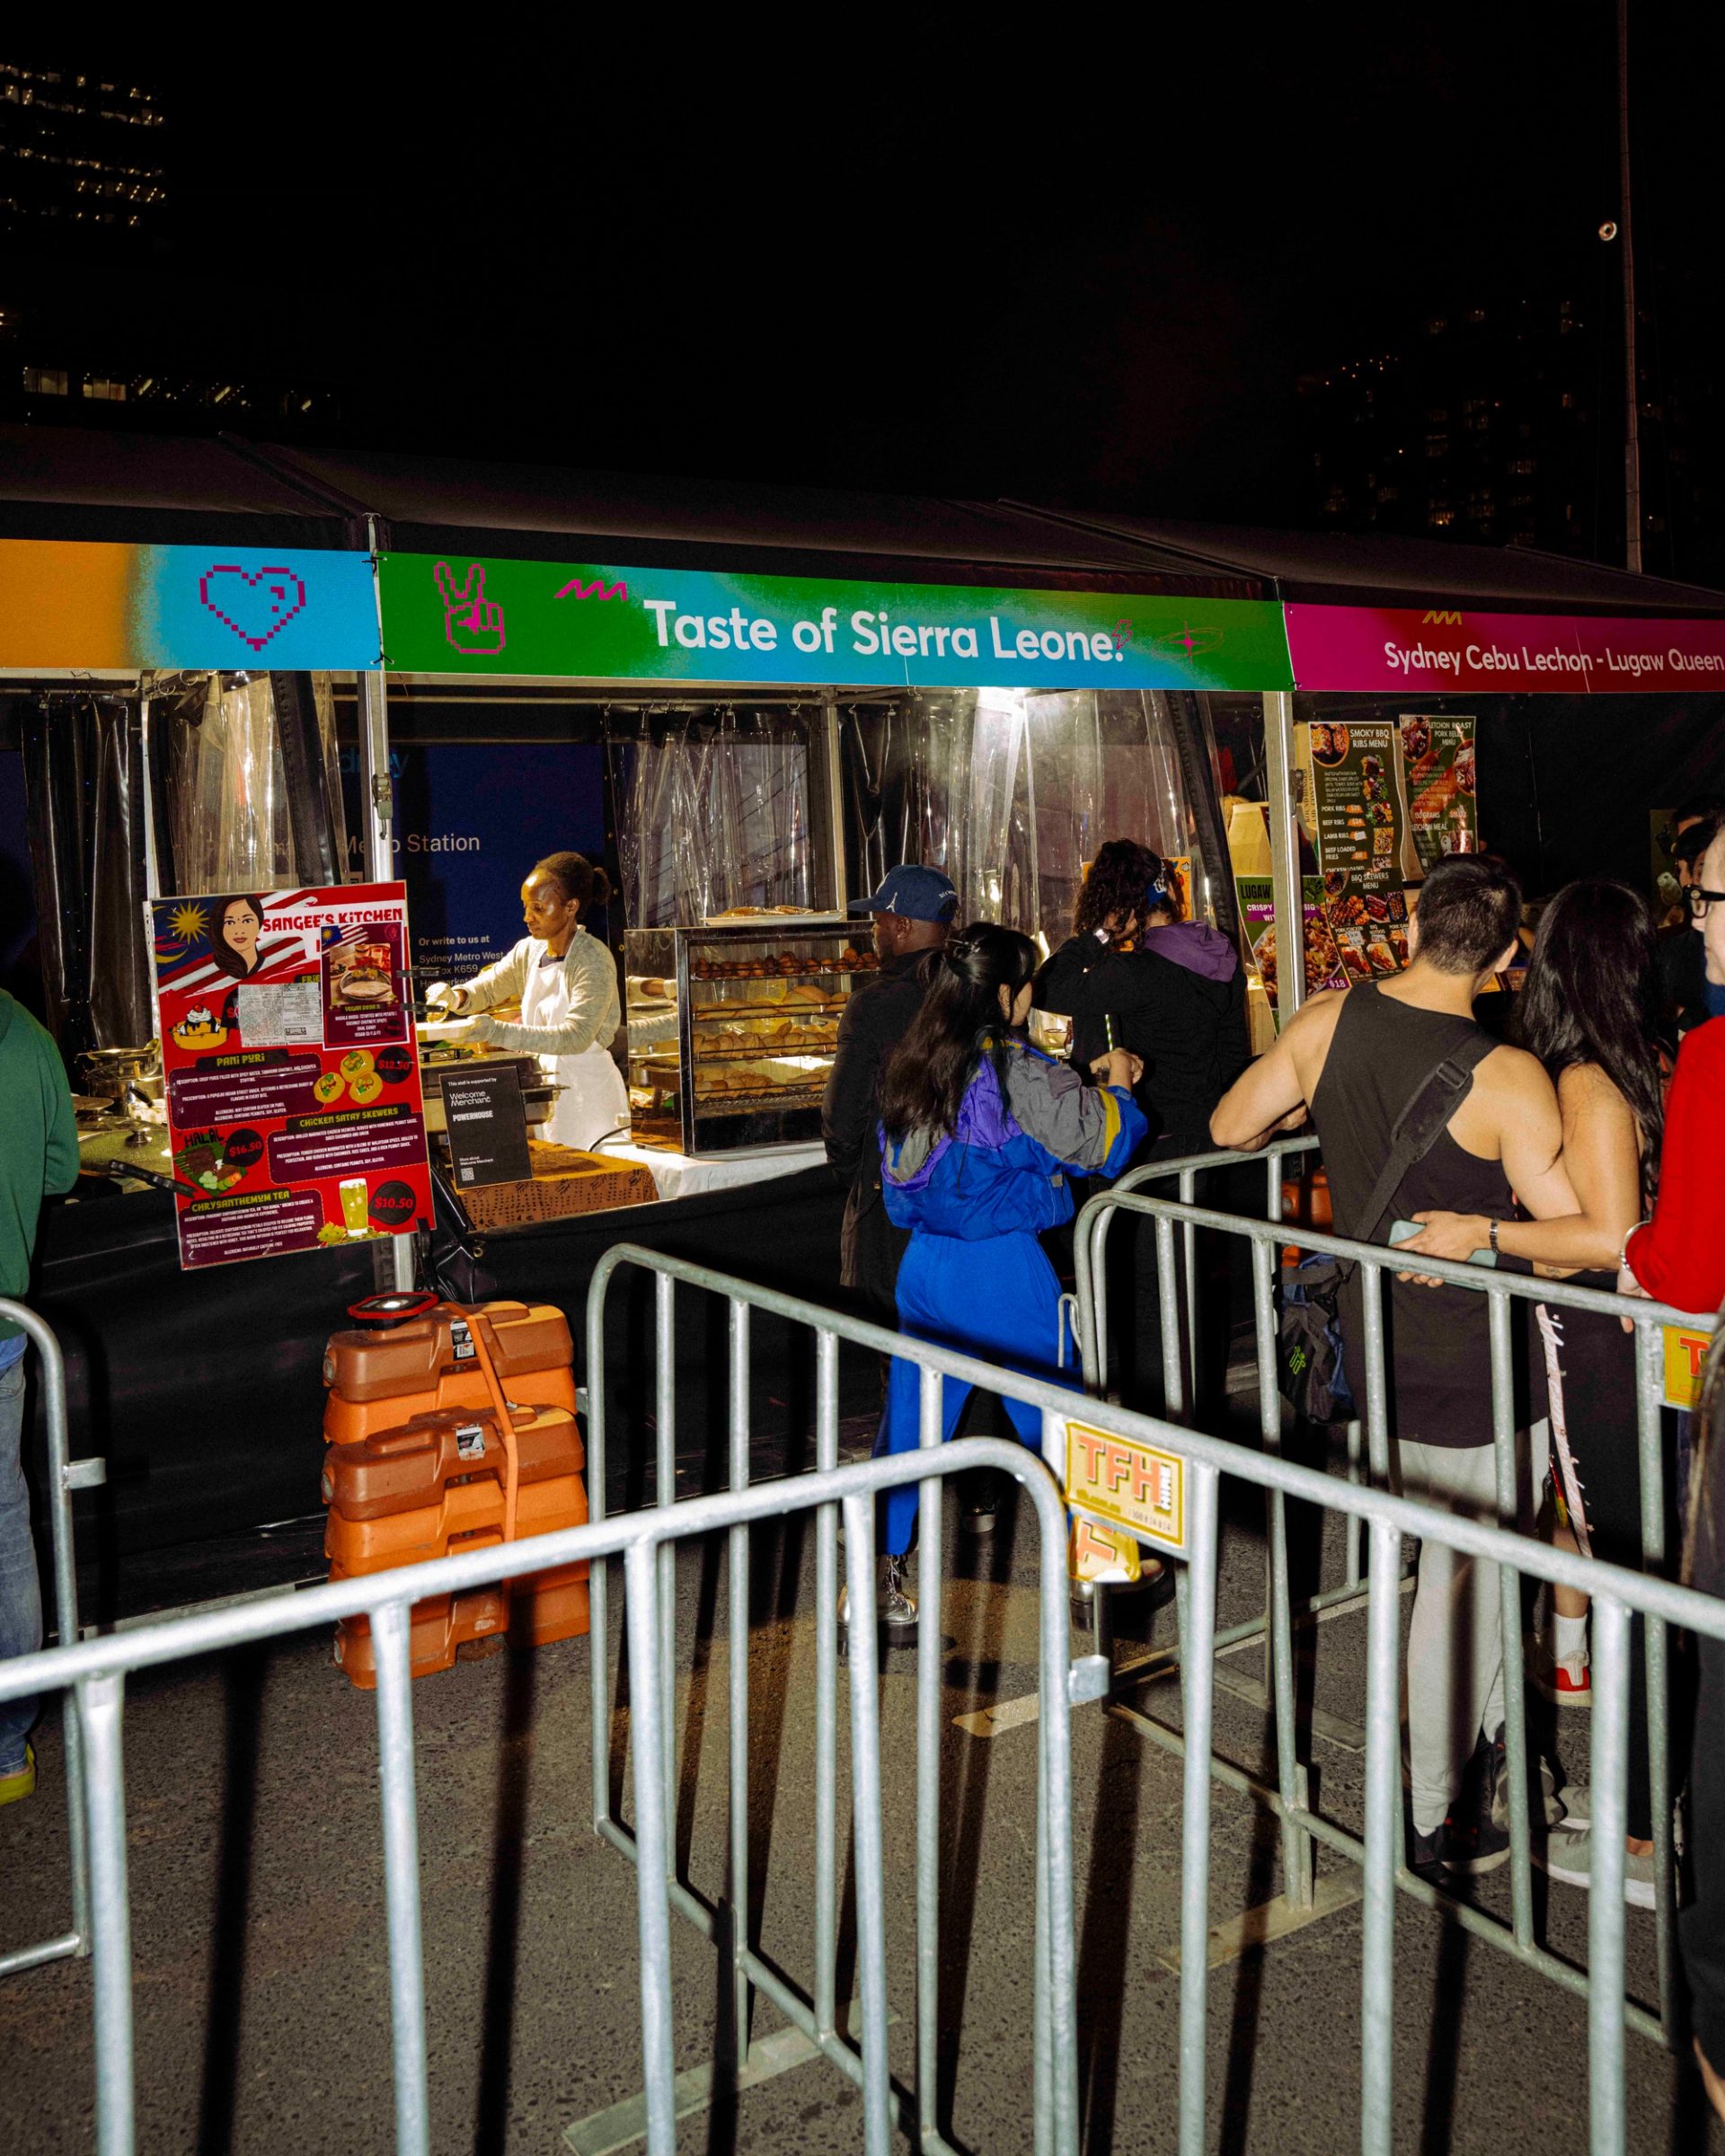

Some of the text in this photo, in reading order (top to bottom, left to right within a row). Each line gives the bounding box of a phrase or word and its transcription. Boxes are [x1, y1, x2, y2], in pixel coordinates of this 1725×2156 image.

[643, 599, 1123, 662] Taste of Sierra Leone.
[1384, 642, 1460, 676] Sydney
[1466, 644, 1519, 671] Cebu
[1522, 646, 1593, 672] Lechon
[1607, 648, 1664, 677] Lugaw
[1668, 649, 1724, 672] Queen
[1349, 729, 1390, 739] SMOKY BBQ
[1352, 739, 1388, 748] RIBS MENU
[407, 833, 481, 853] Station
[1350, 872, 1389, 883] BBQ SKEWERS
[1240, 885, 1270, 899] LUGAW
[1246, 904, 1272, 912] CRISPY
[263, 913, 334, 932] SANGEE'S
[419, 937, 429, 947] Or
[431, 936, 456, 946] write
[456, 936, 466, 945] to
[480, 934, 490, 944] at
[419, 951, 504, 965] Sydney Metro West
[454, 964, 478, 974] K659
[1329, 979, 1347, 988] $18
[378, 1059, 410, 1071] $12.50
[449, 1091, 486, 1100] Welcome
[450, 1096, 491, 1108] Merchant
[335, 1111, 359, 1122] SATAY
[361, 1107, 398, 1119] SKEWERS
[452, 1110, 493, 1122] POWERHOUSE
[183, 1127, 226, 1148] HALAL
[229, 1141, 262, 1158] $16.50
[191, 1190, 289, 1212] CHRYSANTHEMUM TEA
[374, 1195, 413, 1211] $10.50
[1076, 1434, 1172, 1512] TFH HIRE
